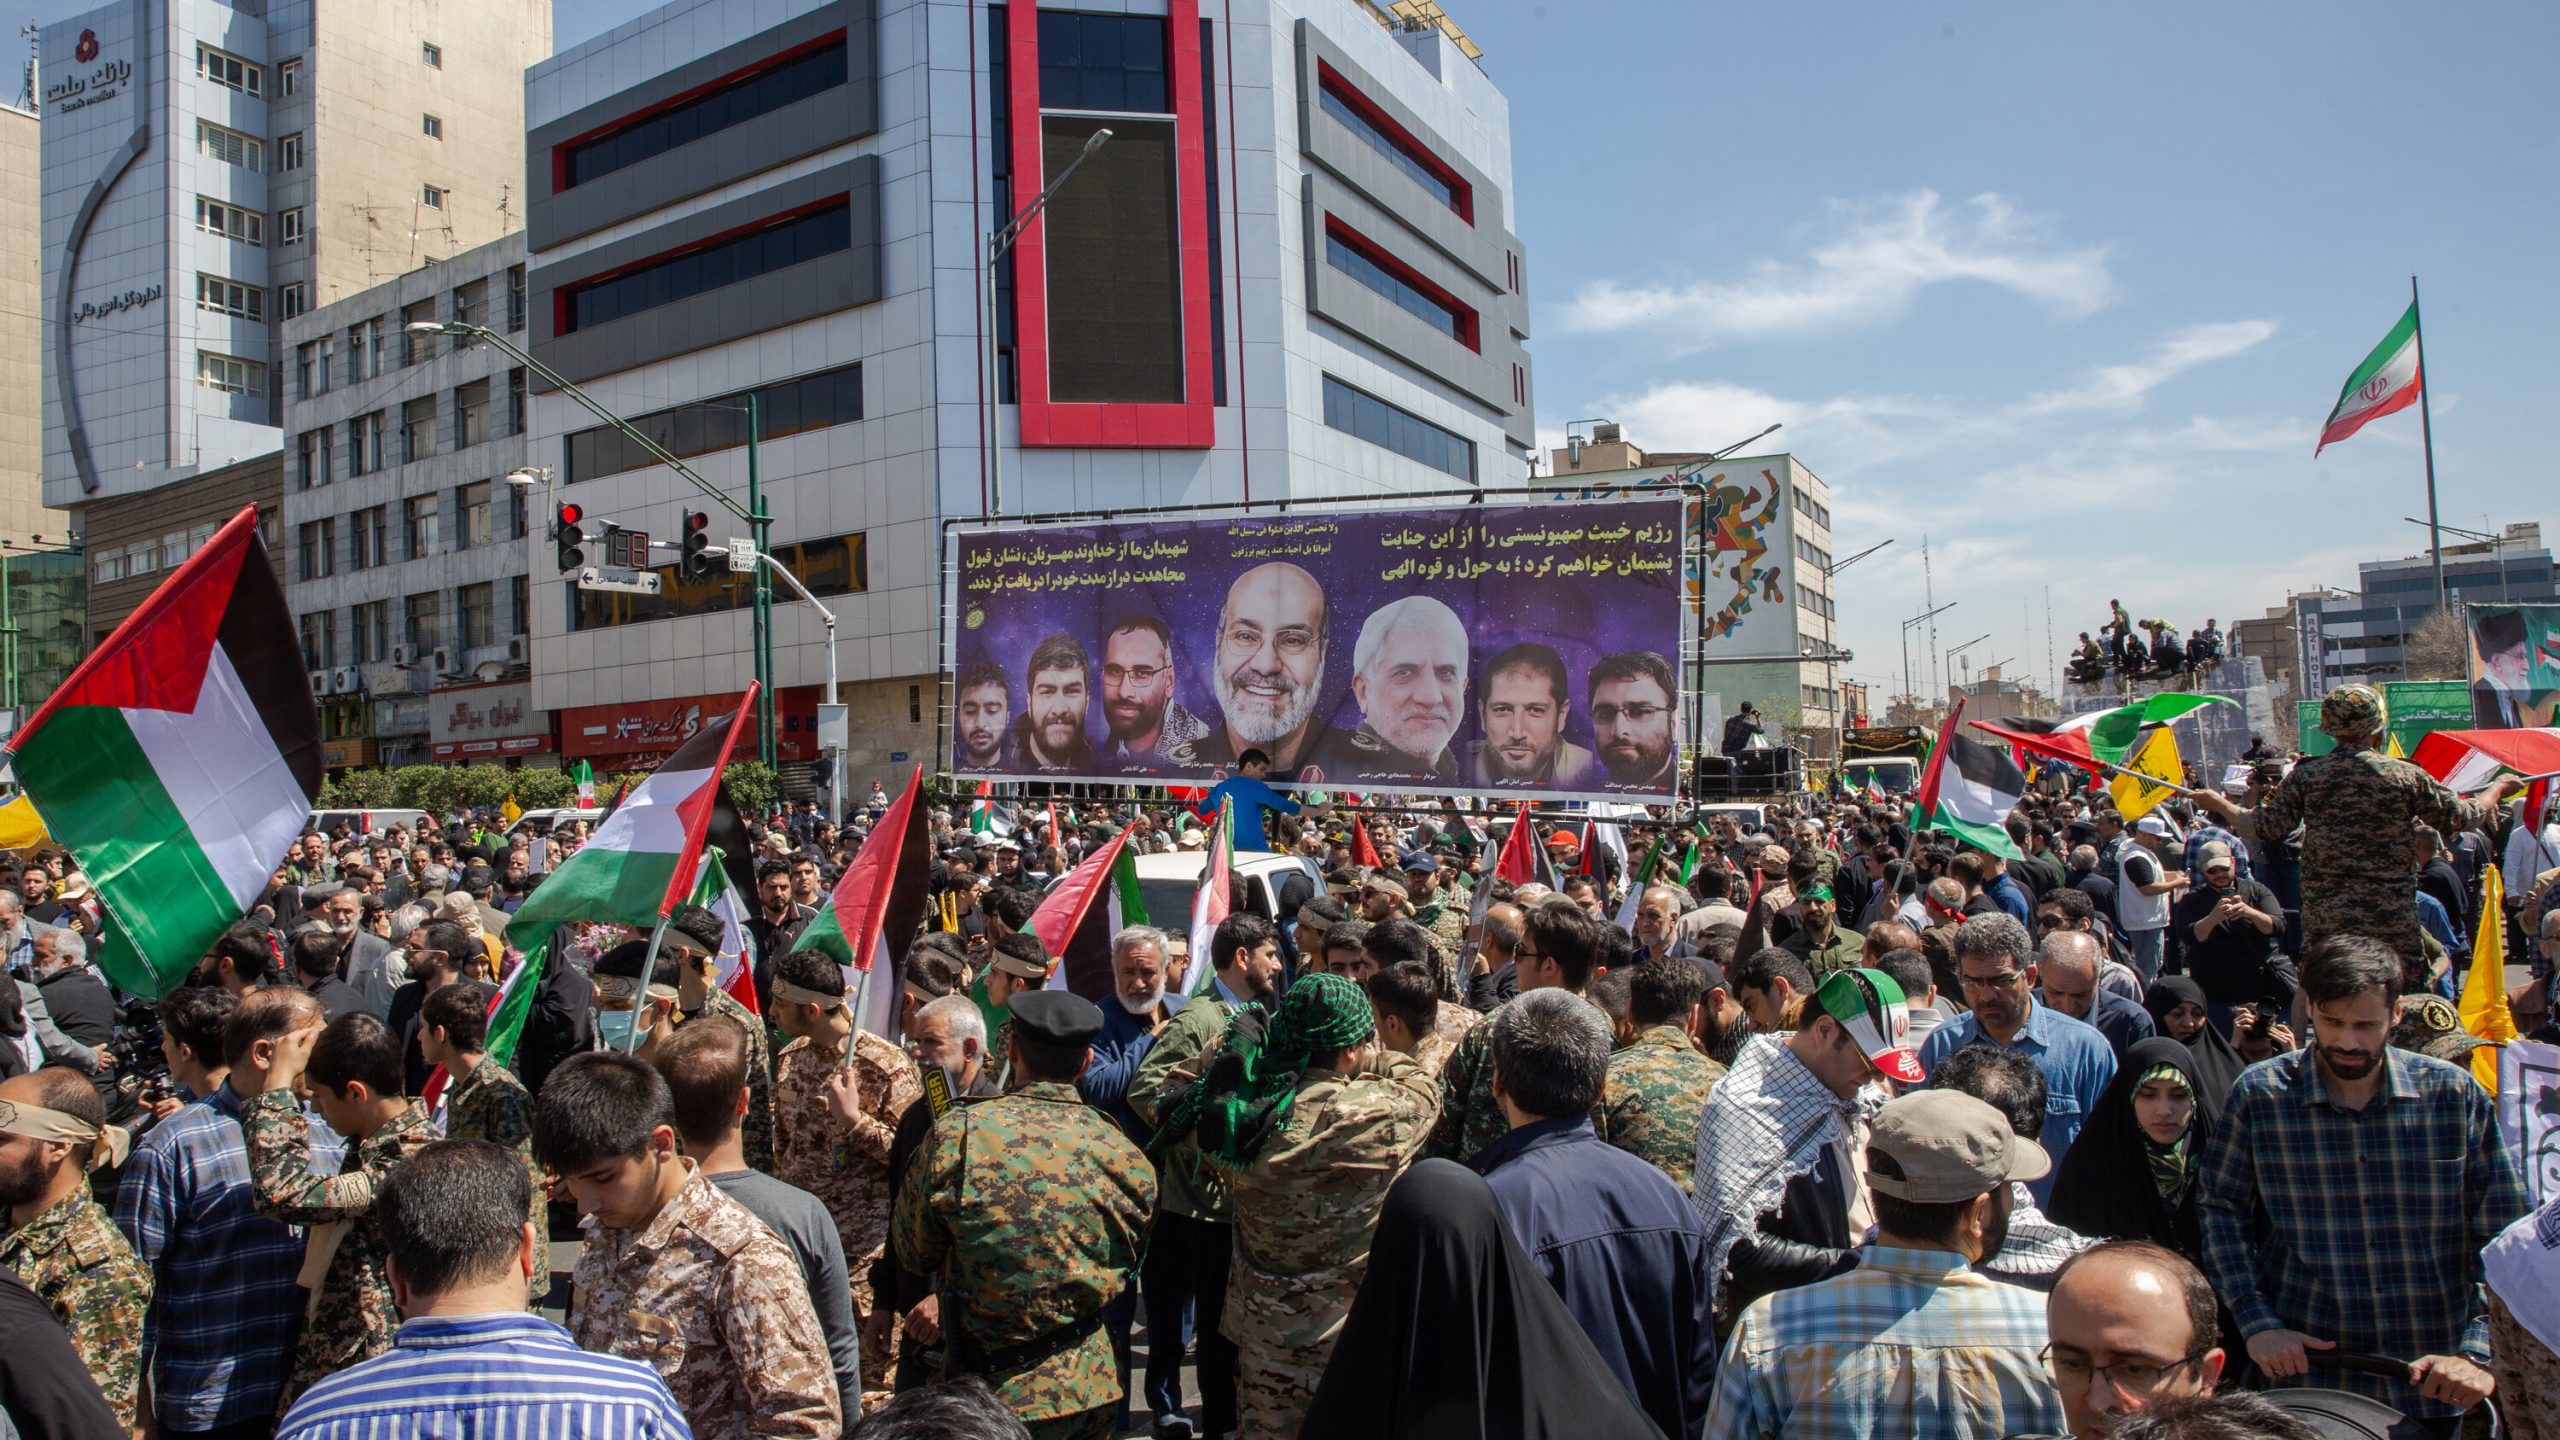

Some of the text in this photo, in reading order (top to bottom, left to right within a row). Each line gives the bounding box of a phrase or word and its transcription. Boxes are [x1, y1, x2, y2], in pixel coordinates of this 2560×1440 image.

[47, 59, 131, 104] بانک ملت
[73, 284, 161, 323] اداره کل امور مالی
[1381, 521, 1673, 550] رژیم خبیث صهیونیستی را از این جنایت
[1074, 541, 1116, 563] خداوند
[1116, 541, 1128, 561] از
[1130, 540, 1142, 556] ما
[1143, 539, 1189, 560] شهیدان
[1381, 558, 1415, 581] الهی
[1418, 556, 1443, 580] قوه
[1444, 564, 1455, 580] و
[1457, 556, 1493, 579] حول
[1496, 559, 1511, 578] به
[1557, 553, 1613, 577] خواهیم
[1617, 551, 1673, 576] پشیمان
[1005, 571, 1045, 592] دریافت
[2307, 618, 2320, 698] RAZI HOTEL
[613, 704, 682, 739] شرکت صرافی شهر
[2399, 709, 2440, 722] المقدس
[2440, 711, 2462, 721] بیت
